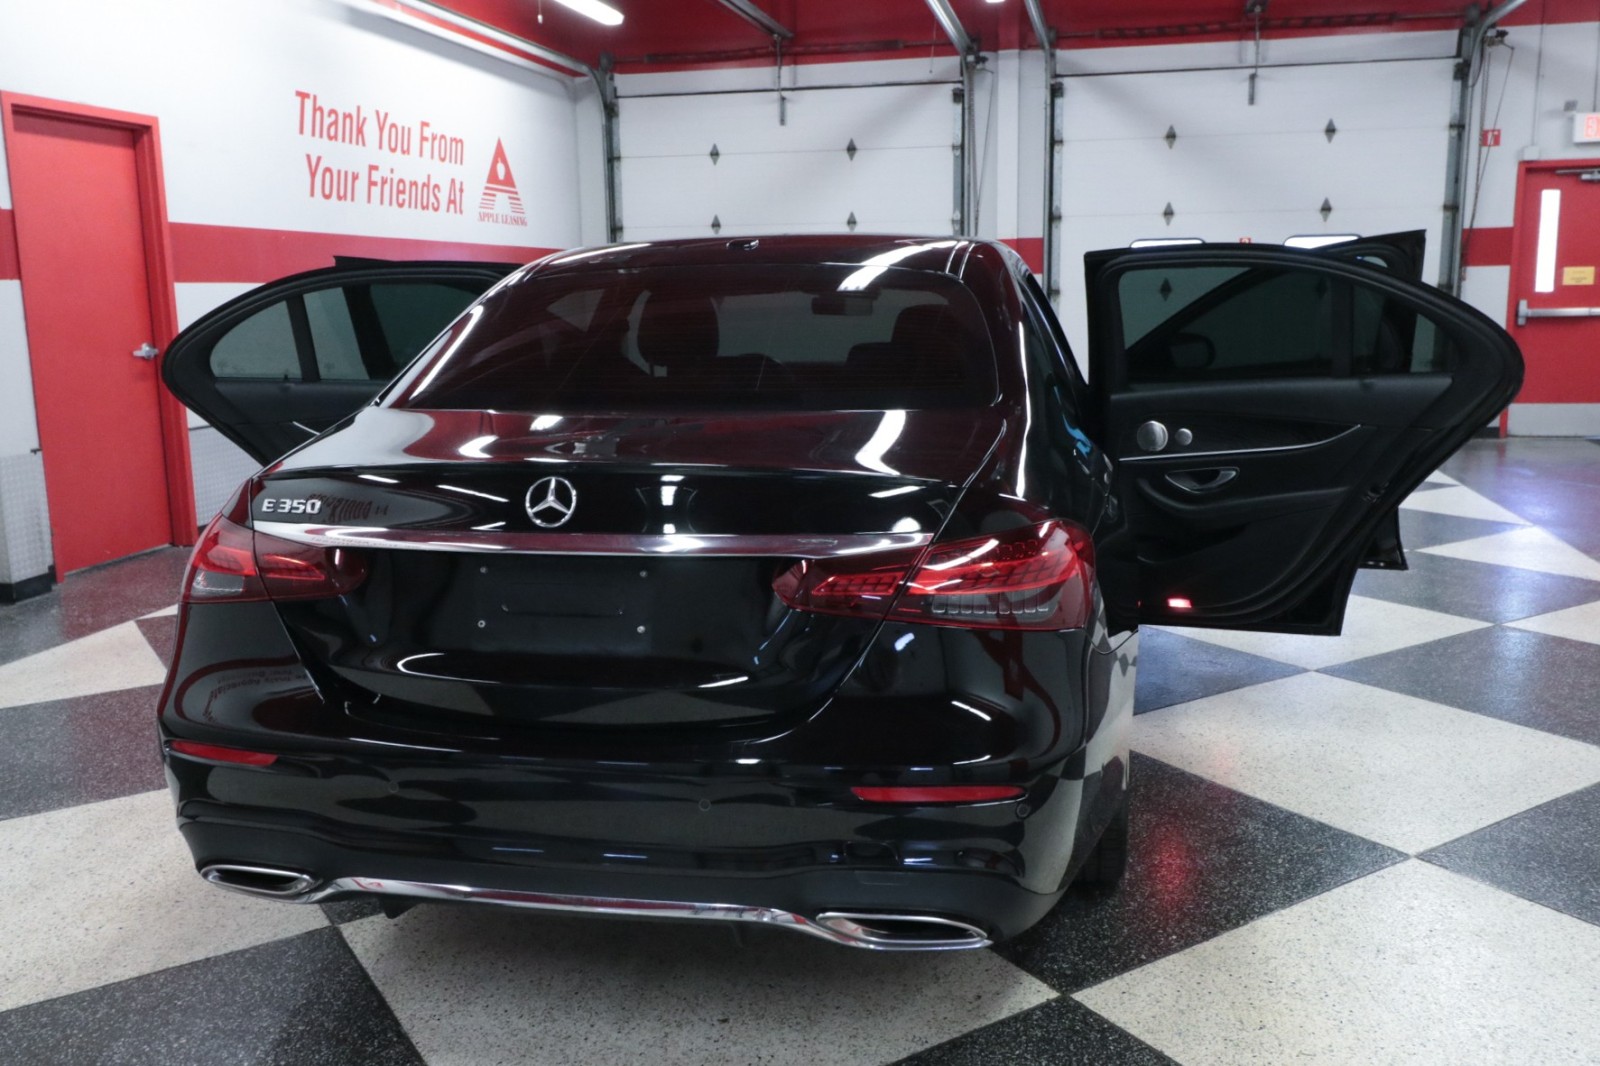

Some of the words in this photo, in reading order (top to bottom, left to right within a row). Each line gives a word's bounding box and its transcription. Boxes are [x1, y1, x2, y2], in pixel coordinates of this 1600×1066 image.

[295, 90, 367, 147] Thank
[375, 109, 412, 156] You
[419, 120, 465, 166] From
[305, 153, 360, 203] Your
[367, 164, 441, 214] Friends
[446, 178, 465, 215] At
[477, 212, 501, 225] APPLE
[501, 214, 528, 227] LEASING
[261, 498, 275, 513] E
[277, 498, 322, 514] 350
